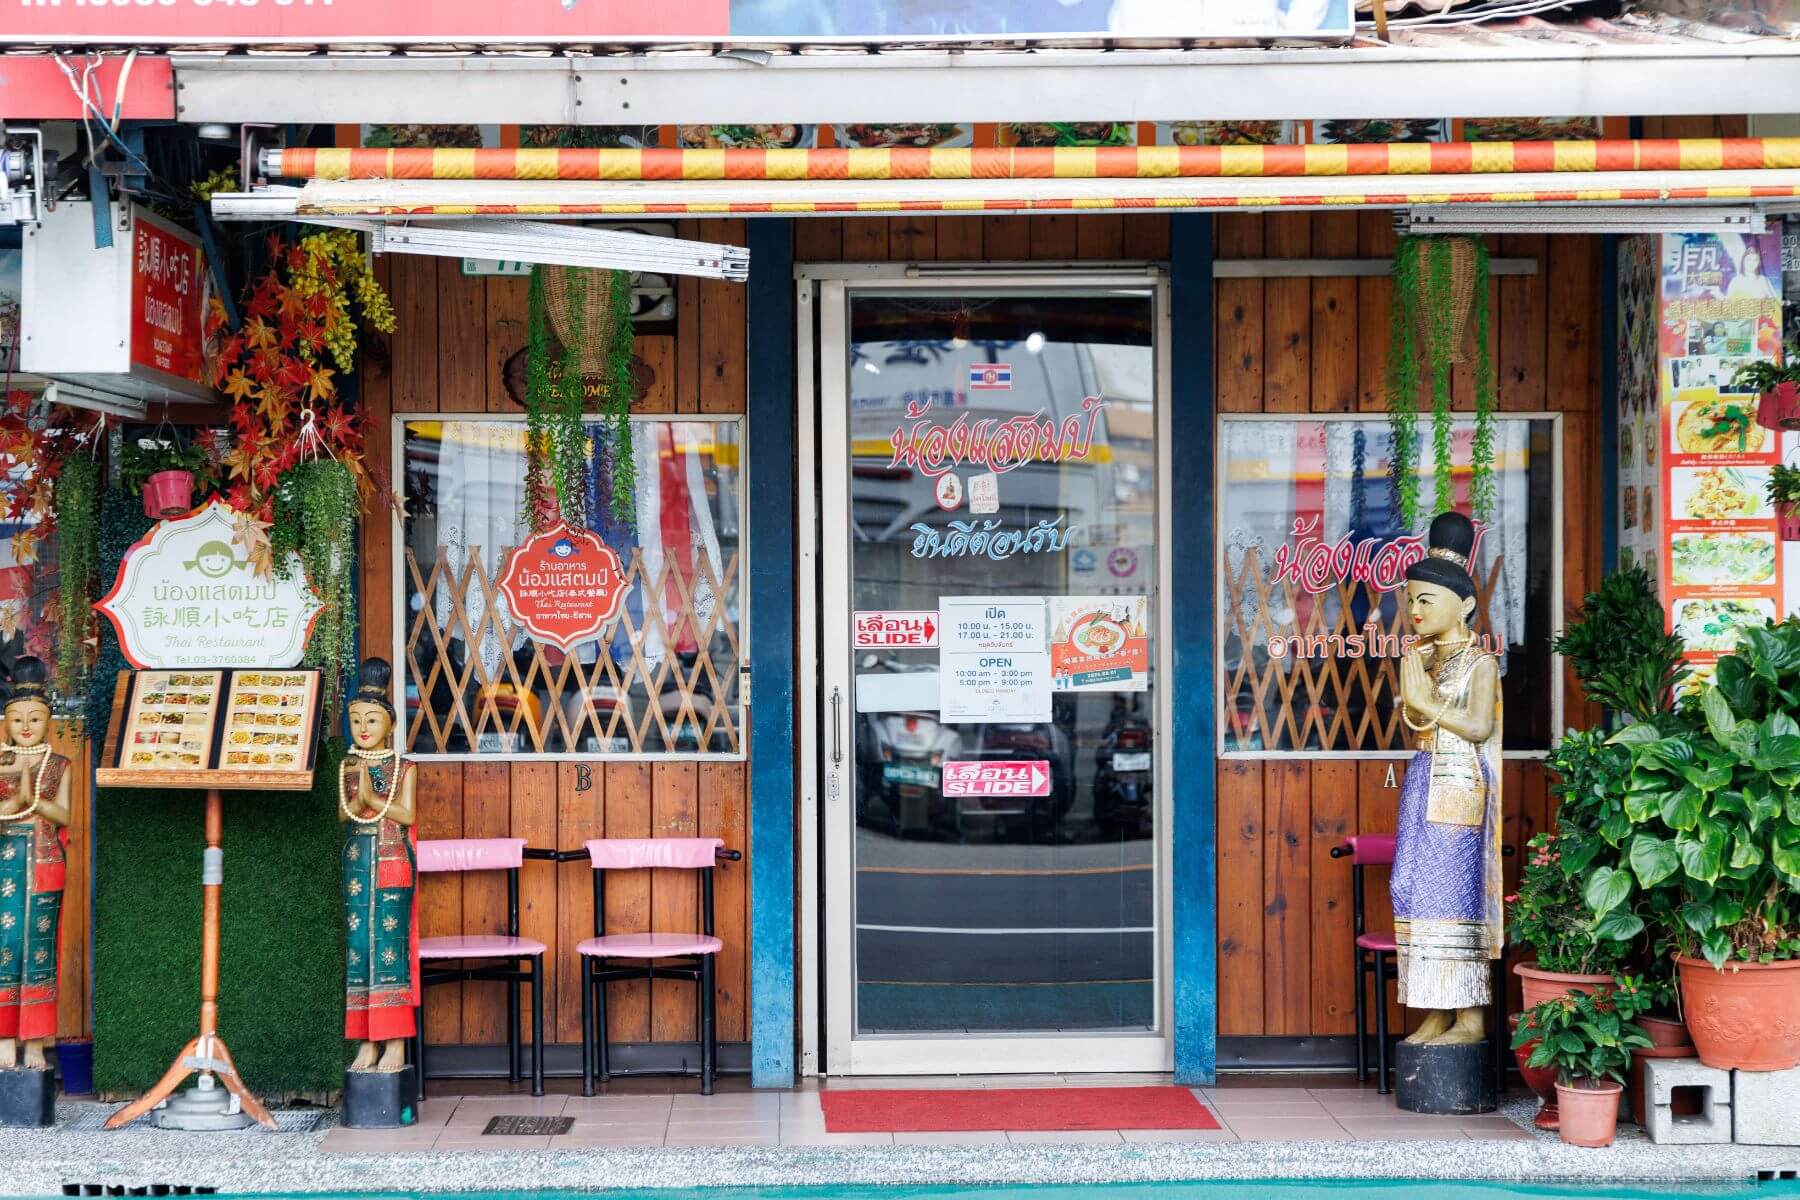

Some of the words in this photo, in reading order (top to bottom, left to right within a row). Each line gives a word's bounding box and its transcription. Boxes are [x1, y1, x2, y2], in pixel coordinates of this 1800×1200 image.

[887, 391, 1112, 476] น้องแสตมป์
[540, 560, 587, 571] ร้านอาหาร
[518, 567, 608, 587] น้องแสตมป์
[143, 606, 289, 628] 詠順小吃店
[985, 607, 1006, 619] เปิด
[958, 622, 981, 630] 10.00
[1000, 622, 1024, 630] 15.00
[165, 635, 193, 648] Thai
[197, 635, 265, 648] Restaurant
[857, 633, 922, 644] SLIDE
[958, 631, 981, 639] 17.00
[1000, 631, 1024, 639] 21.00
[979, 658, 1012, 668] OPEN
[575, 764, 592, 792] B
[1383, 762, 1399, 789] A
[947, 781, 1031, 794] SLIDE
